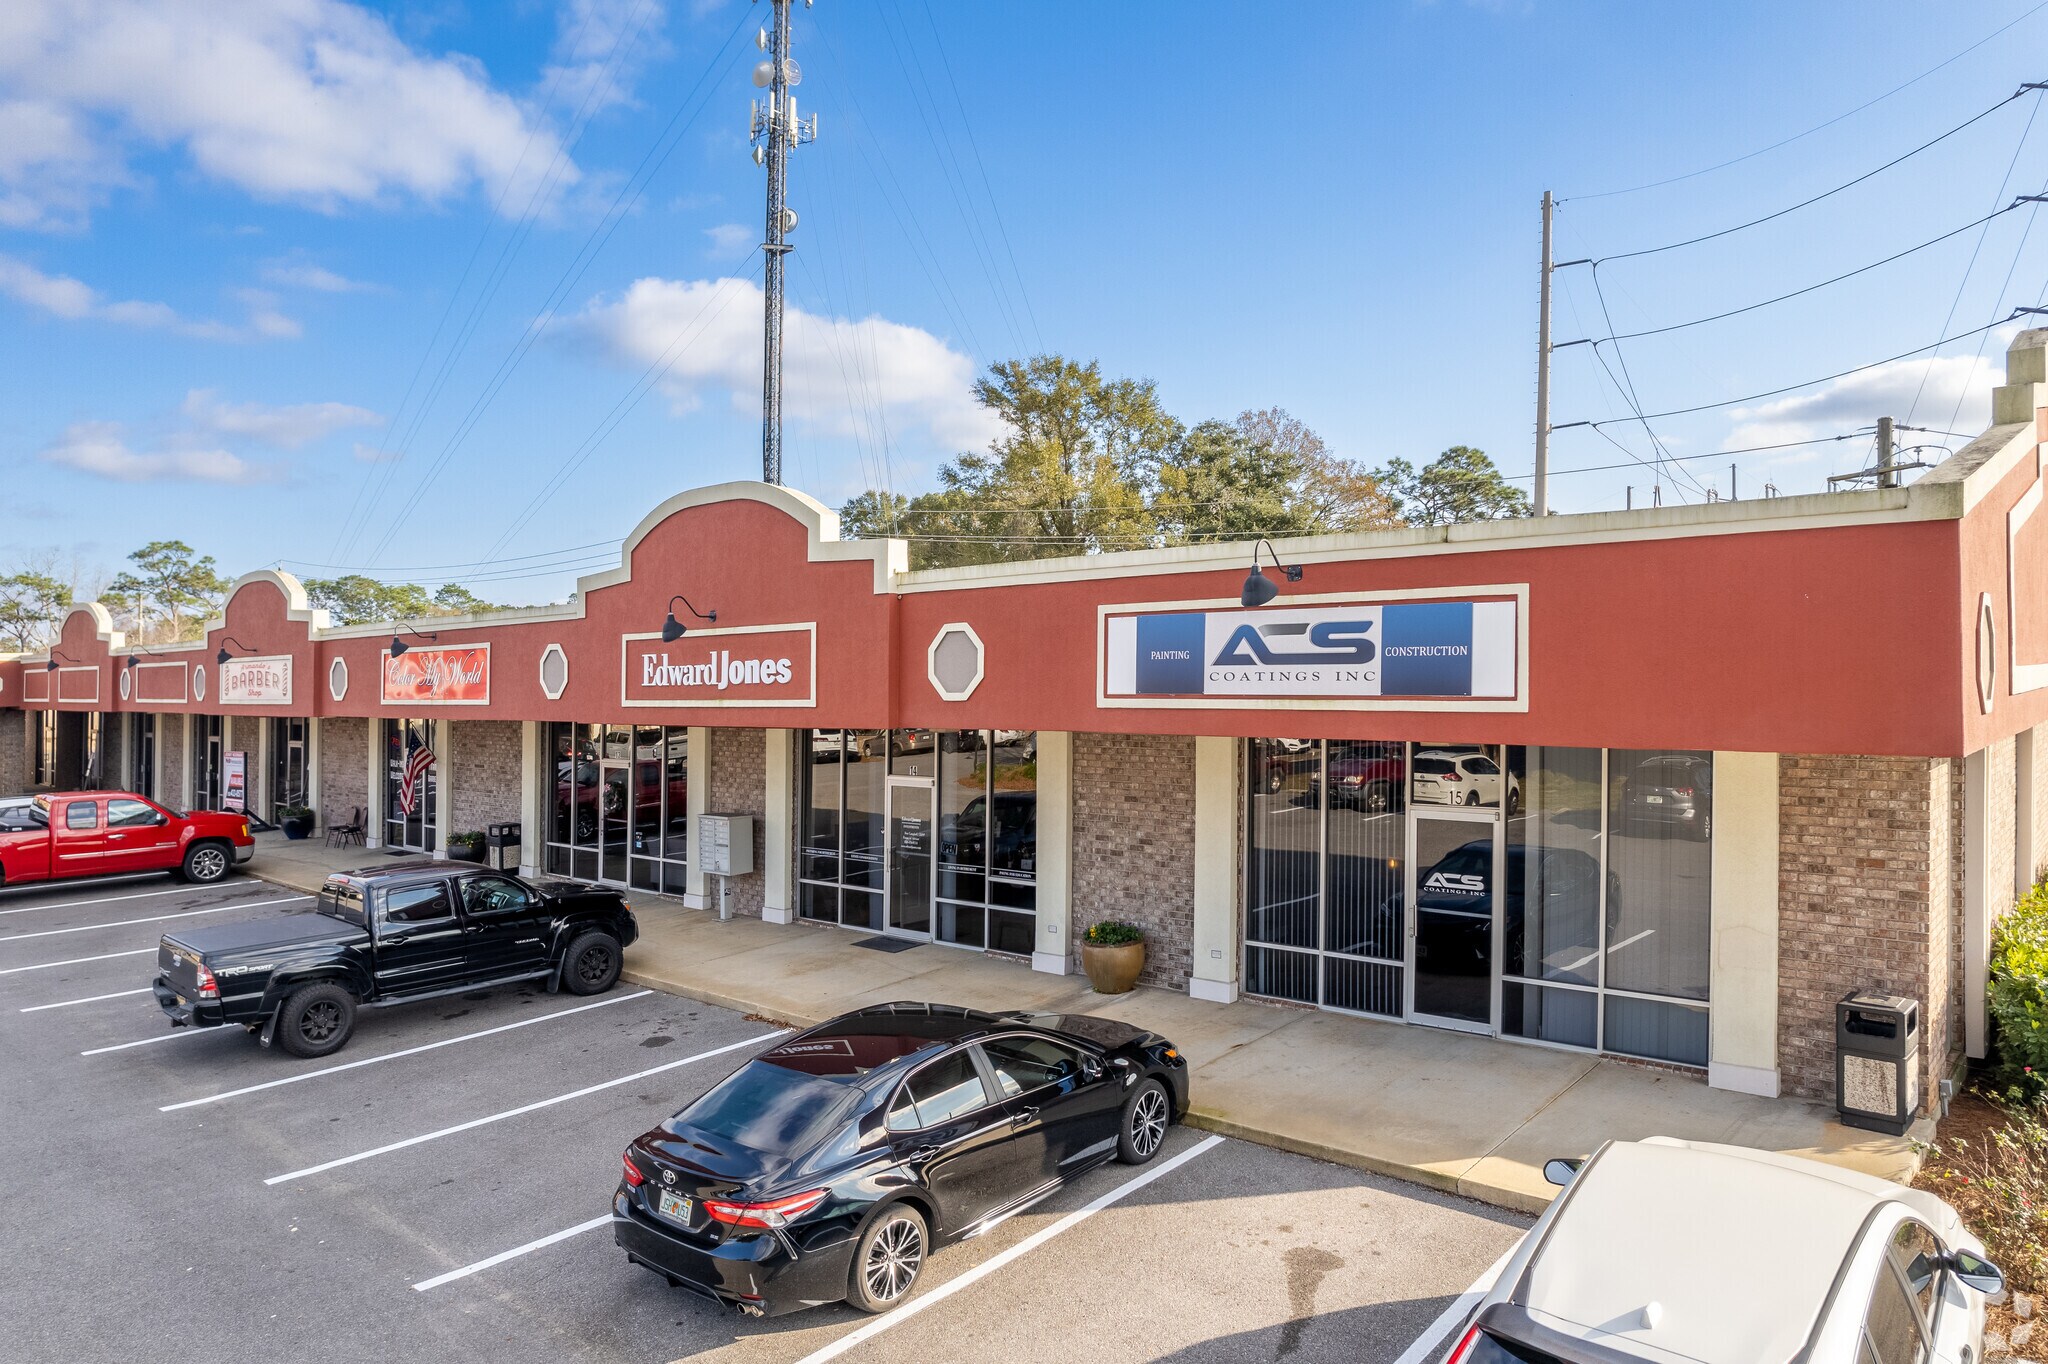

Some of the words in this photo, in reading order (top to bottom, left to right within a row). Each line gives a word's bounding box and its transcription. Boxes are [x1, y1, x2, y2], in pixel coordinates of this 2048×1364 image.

[1210, 620, 1376, 666] ACS
[1151, 650, 1190, 660] PAINTING
[1385, 645, 1468, 657] CONSTRUCTION
[386, 658, 417, 687] Color
[444, 651, 484, 686] World
[641, 650, 792, 690] EdwardJones
[231, 670, 280, 690] BARBER
[1209, 671, 1321, 682] COATINGS
[1336, 671, 1376, 682] INC
[247, 689, 262, 698] Shop
[909, 765, 918, 776] 14
[1449, 790, 1463, 805] 15
[941, 842, 957, 856] OPEN
[1425, 872, 1485, 891] ACS
[1423, 886, 1467, 895] COATINGS
[214, 965, 248, 978] TRD
[248, 964, 274, 972] SPORT
